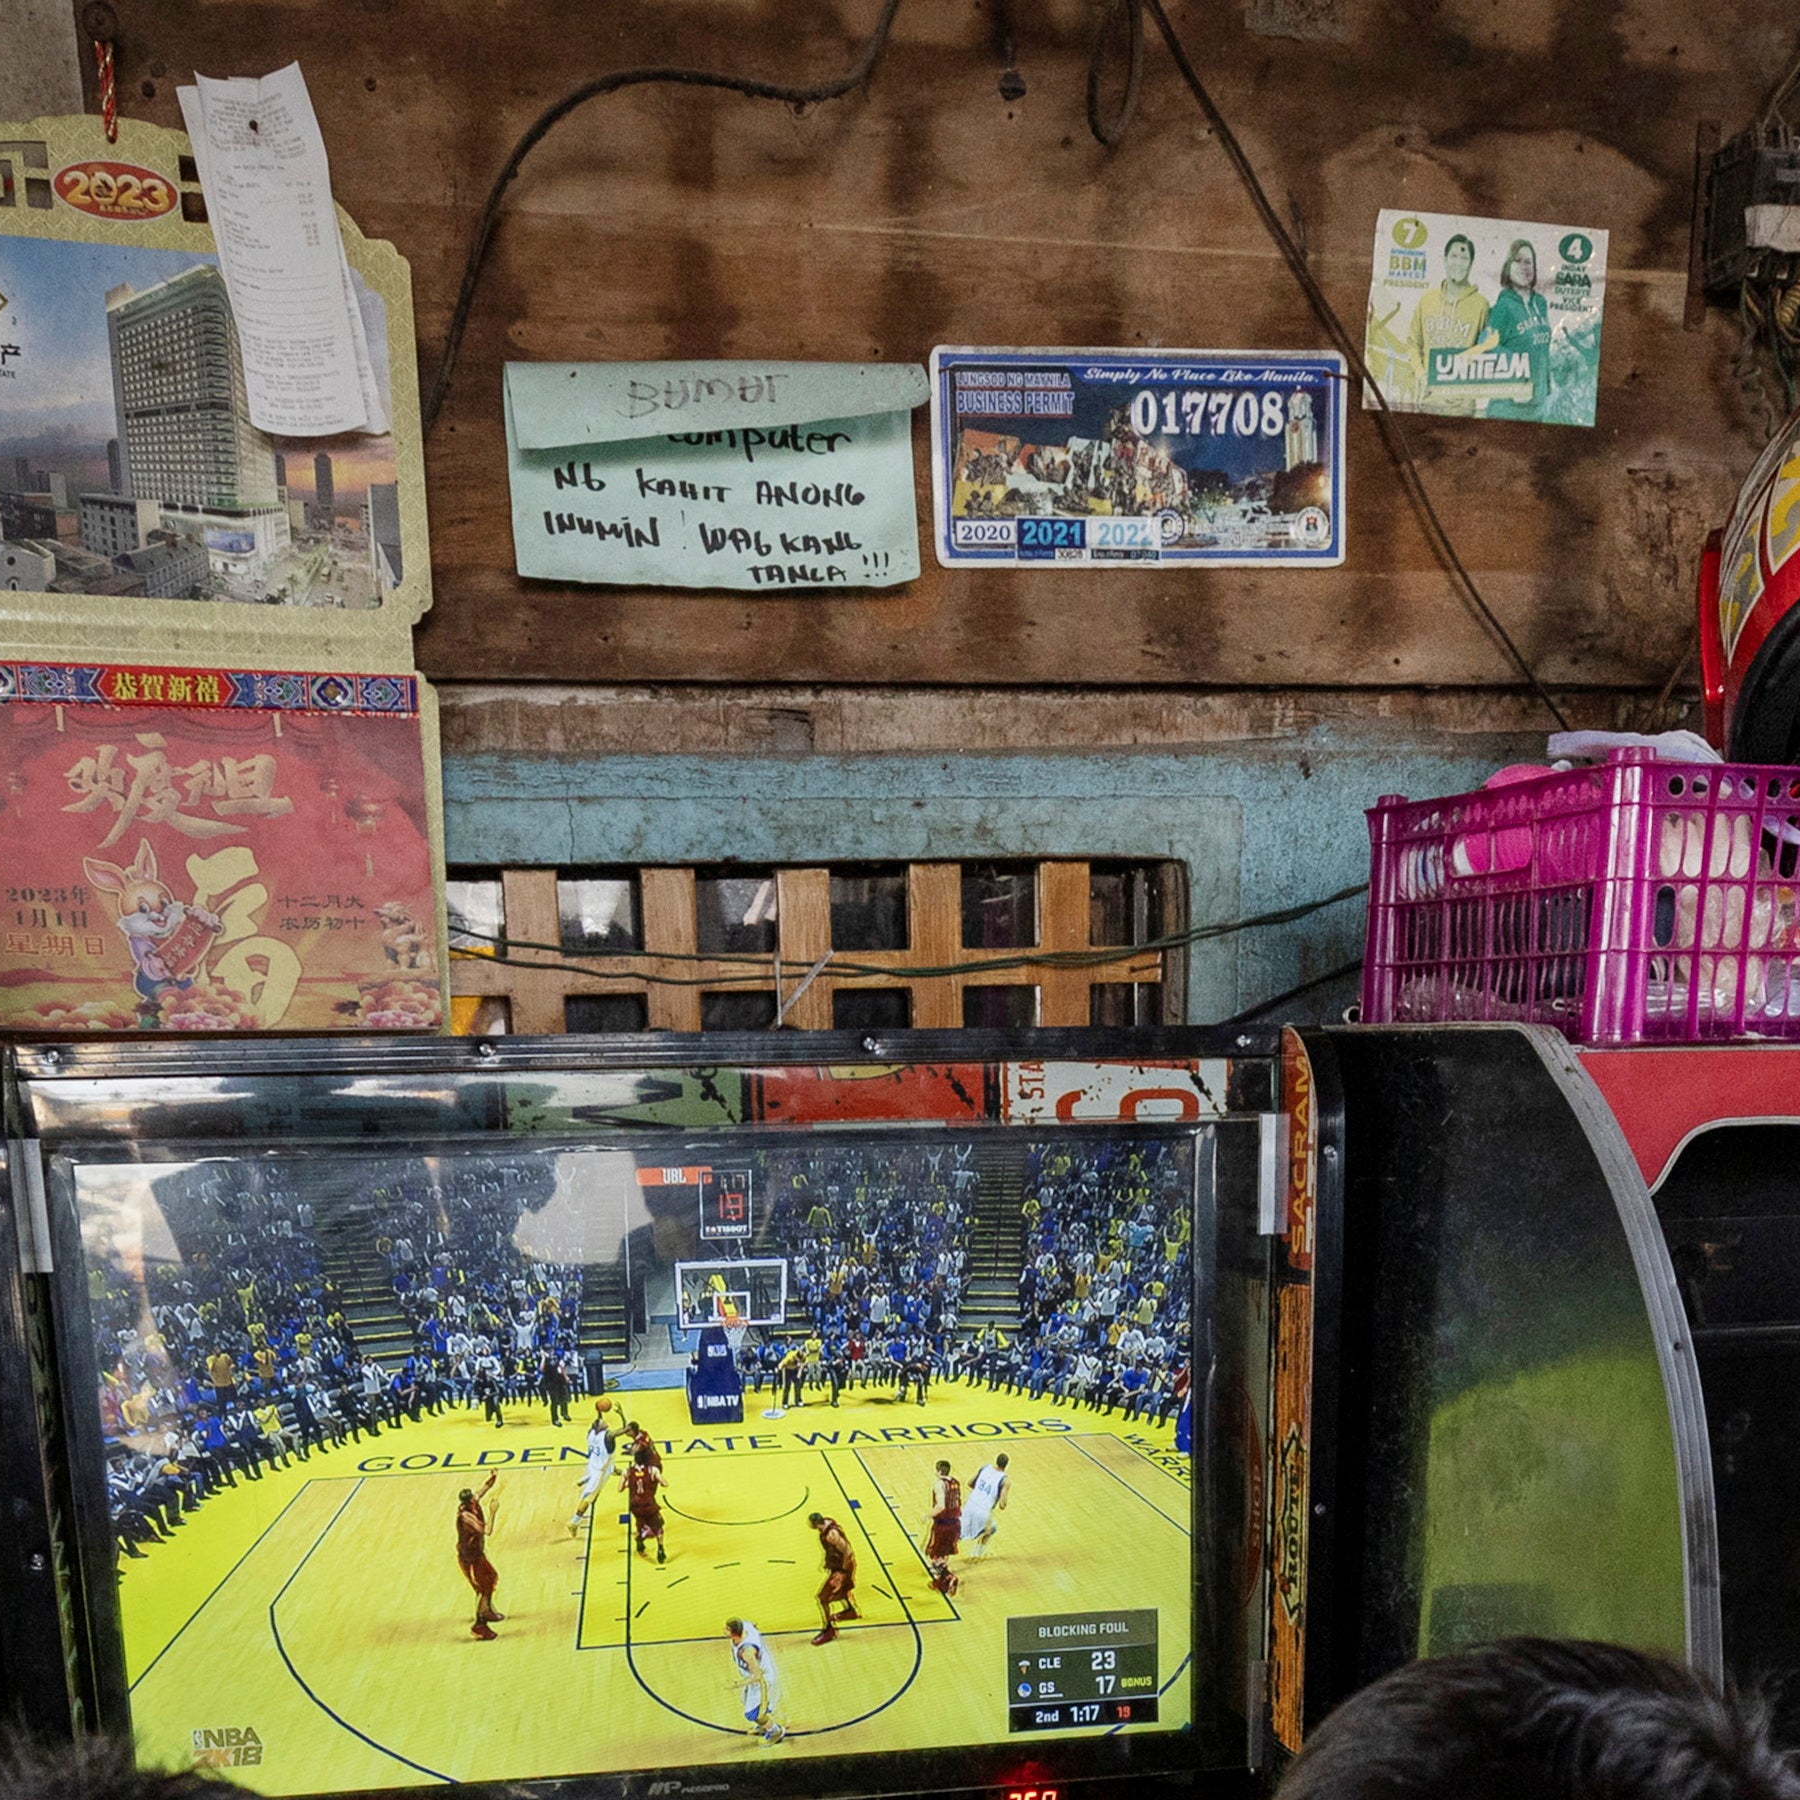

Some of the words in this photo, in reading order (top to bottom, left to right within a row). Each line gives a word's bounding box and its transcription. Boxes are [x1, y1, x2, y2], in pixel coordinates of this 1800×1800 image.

[63, 170, 170, 212] 2023
[1388, 254, 1427, 273] BBM
[956, 391, 1022, 414] BUSINESS
[1024, 393, 1075, 414] PERMIT
[1131, 390, 1285, 436] 017708
[635, 467, 733, 503] KAHIT
[960, 525, 1011, 541] 2020
[1021, 520, 1083, 546] 2021
[1099, 523, 1151, 546] 2022
[111, 672, 221, 703] 恭賀新禧
[4, 932, 105, 958] 星期日
[357, 1445, 591, 1474] GOLDEN
[795, 1417, 1074, 1446] WARRIORS
[1038, 1623, 1097, 1638] BLOCKING
[1099, 1622, 1129, 1634] FOUL
[1038, 1657, 1061, 1669] CLE
[1090, 1651, 1116, 1671] 23
[1038, 1682, 1055, 1694] GS
[1095, 1675, 1116, 1695] 17
[1120, 1676, 1153, 1688] BONUS
[1035, 1710, 1059, 1723] 2nd
[1069, 1705, 1100, 1722] 1:17
[1116, 1706, 1131, 1718] 19
[203, 1727, 262, 1749] NBA
[192, 1747, 264, 1769] 2K18
